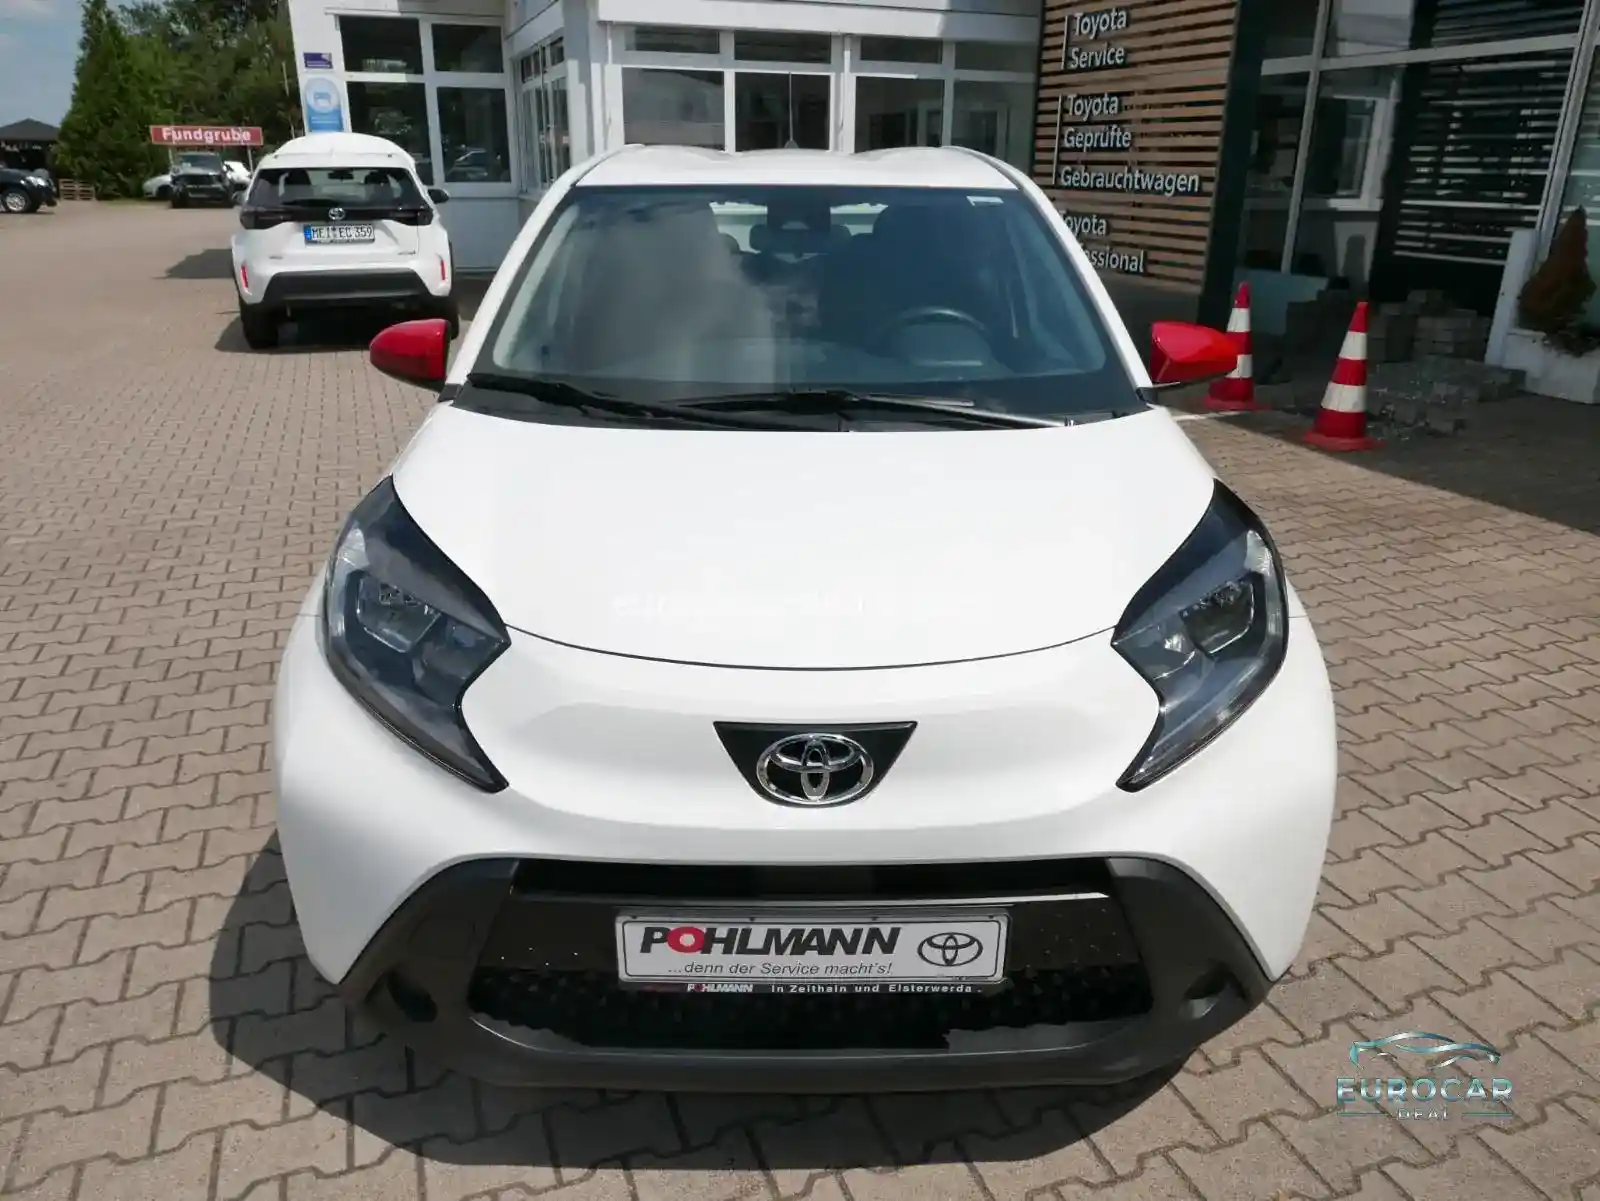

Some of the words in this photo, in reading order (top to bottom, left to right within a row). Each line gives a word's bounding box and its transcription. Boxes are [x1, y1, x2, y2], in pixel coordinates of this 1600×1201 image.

[1073, 8, 1128, 40] Toyota
[1070, 45, 1125, 69] Service
[1067, 93, 1119, 121] Toyota
[161, 127, 252, 144] Fundgrube
[1063, 124, 1132, 153] Geprüfte
[1060, 166, 1200, 197] Gebrauchtwagen
[311, 226, 331, 239] MEI
[354, 227, 373, 239] 359
[1080, 243, 1145, 273] ssional
[640, 926, 901, 956] POHLMANN
[729, 962, 755, 975] der
[760, 961, 820, 975] Service
[789, 984, 847, 993] Zeithain
[855, 984, 880, 993] und
